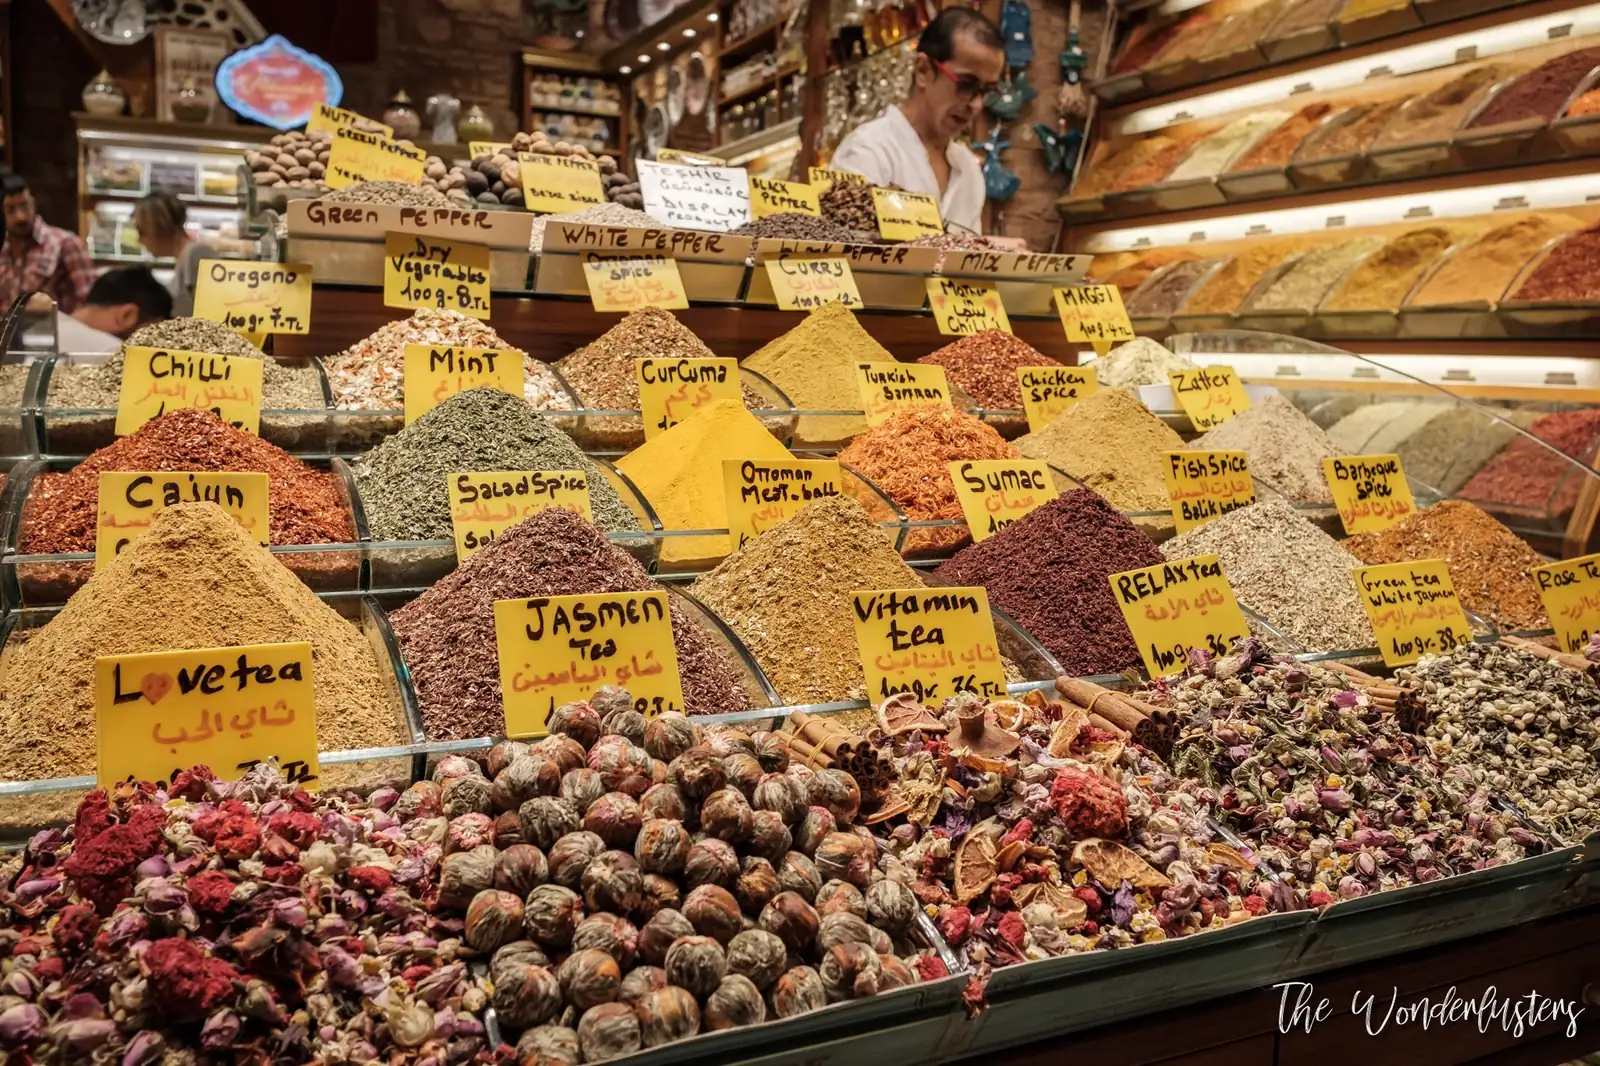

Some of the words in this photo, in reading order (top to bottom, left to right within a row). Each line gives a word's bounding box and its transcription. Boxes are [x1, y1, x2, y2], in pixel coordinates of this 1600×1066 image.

[751, 177, 789, 195] BLACK
[661, 195, 748, 220] DISPLAY
[761, 191, 814, 212] PEPPER
[641, 229, 725, 254] PEPPER
[960, 253, 1002, 272] MIX
[1013, 255, 1077, 271] PEPPER
[210, 262, 298, 289] Oregano
[1061, 285, 1113, 306] MAGGI
[960, 462, 1046, 493] Sumac
[1170, 454, 1208, 480] Fish
[126, 474, 244, 509] Cajun
[1117, 564, 1188, 605] RELAX
[1186, 559, 1223, 581] tea
[1361, 571, 1407, 592] Green
[1410, 570, 1441, 587] tea
[1537, 570, 1581, 592] Rose
[853, 591, 980, 624] Vitamin
[886, 619, 945, 652] tea
[568, 637, 617, 661] Tea
[230, 654, 304, 692] tea
